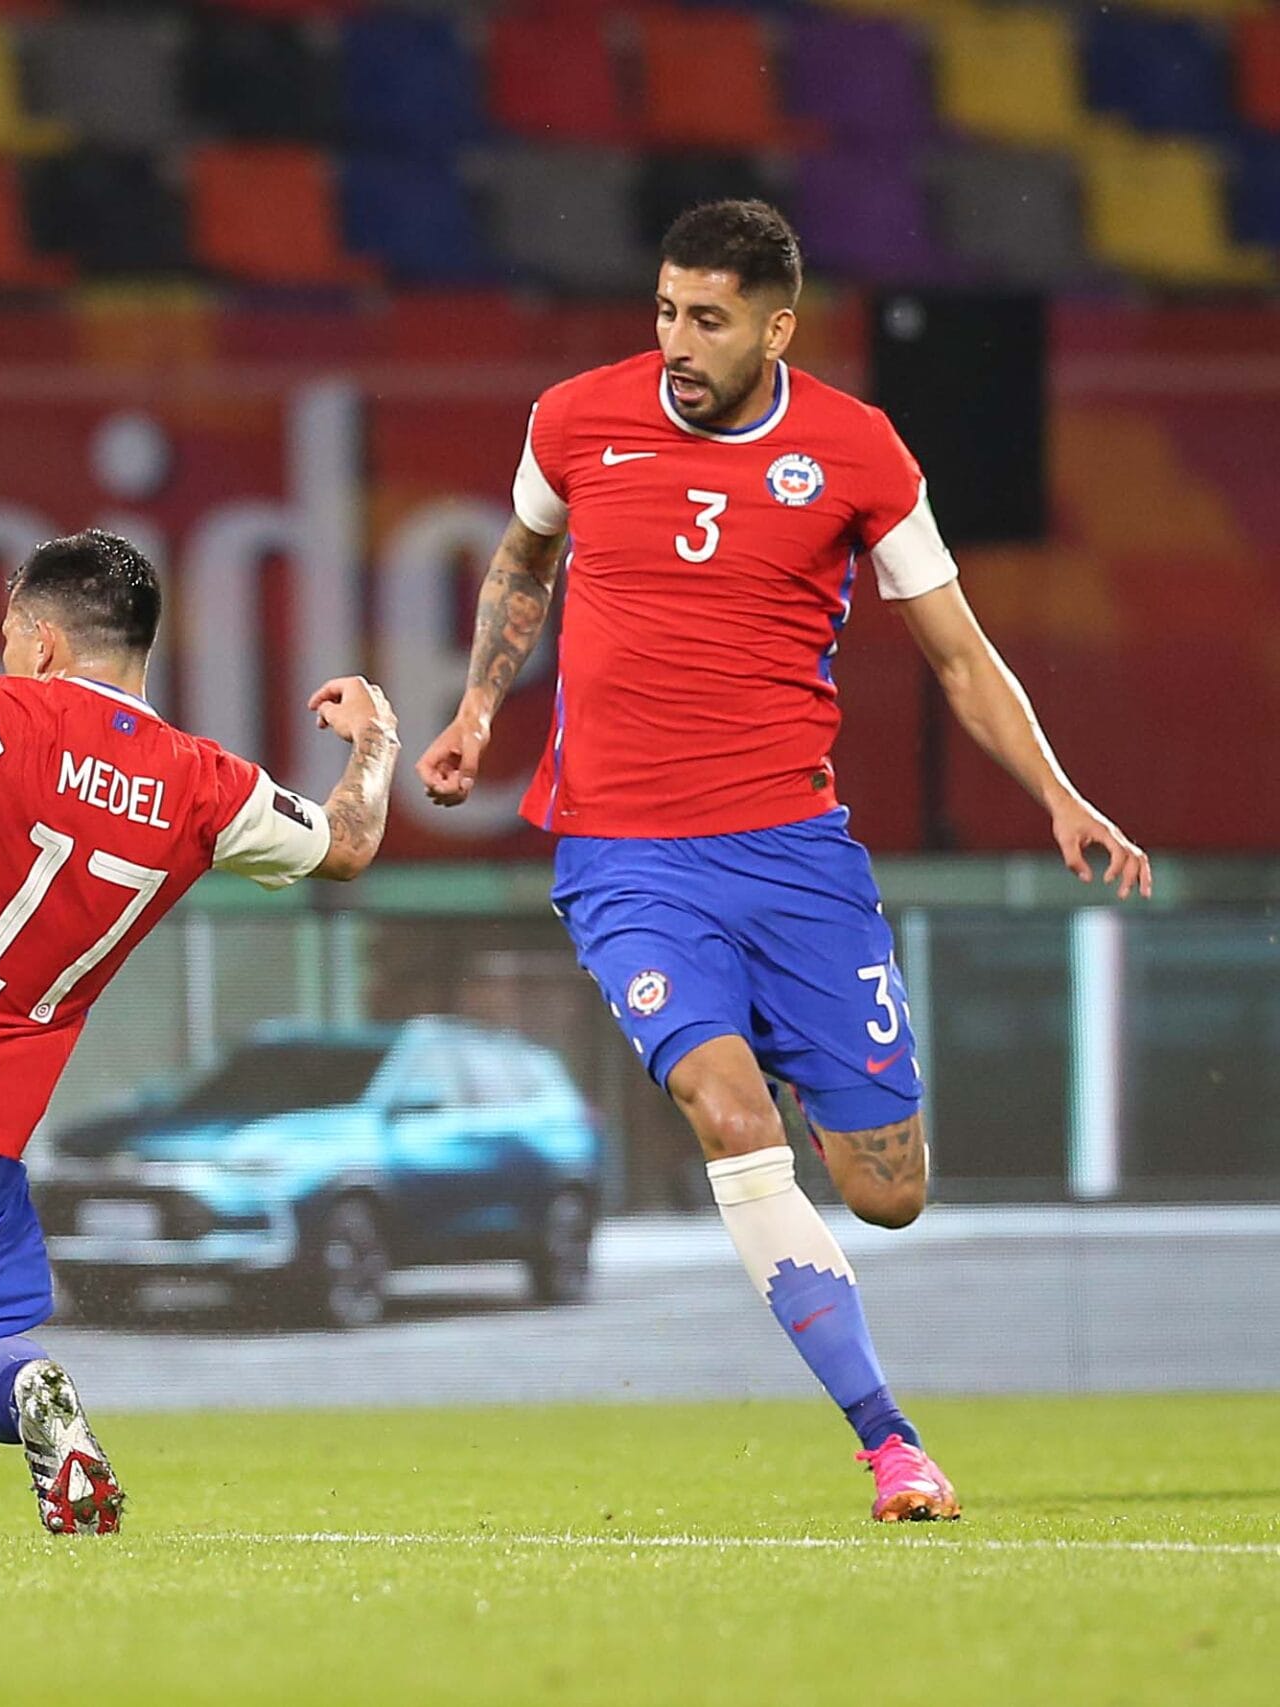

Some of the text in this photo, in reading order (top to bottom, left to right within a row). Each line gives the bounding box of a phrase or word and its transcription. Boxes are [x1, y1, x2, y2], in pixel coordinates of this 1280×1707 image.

[675, 488, 728, 563] 3
[56, 750, 170, 829] MEDEL
[857, 964, 899, 1044] 3
